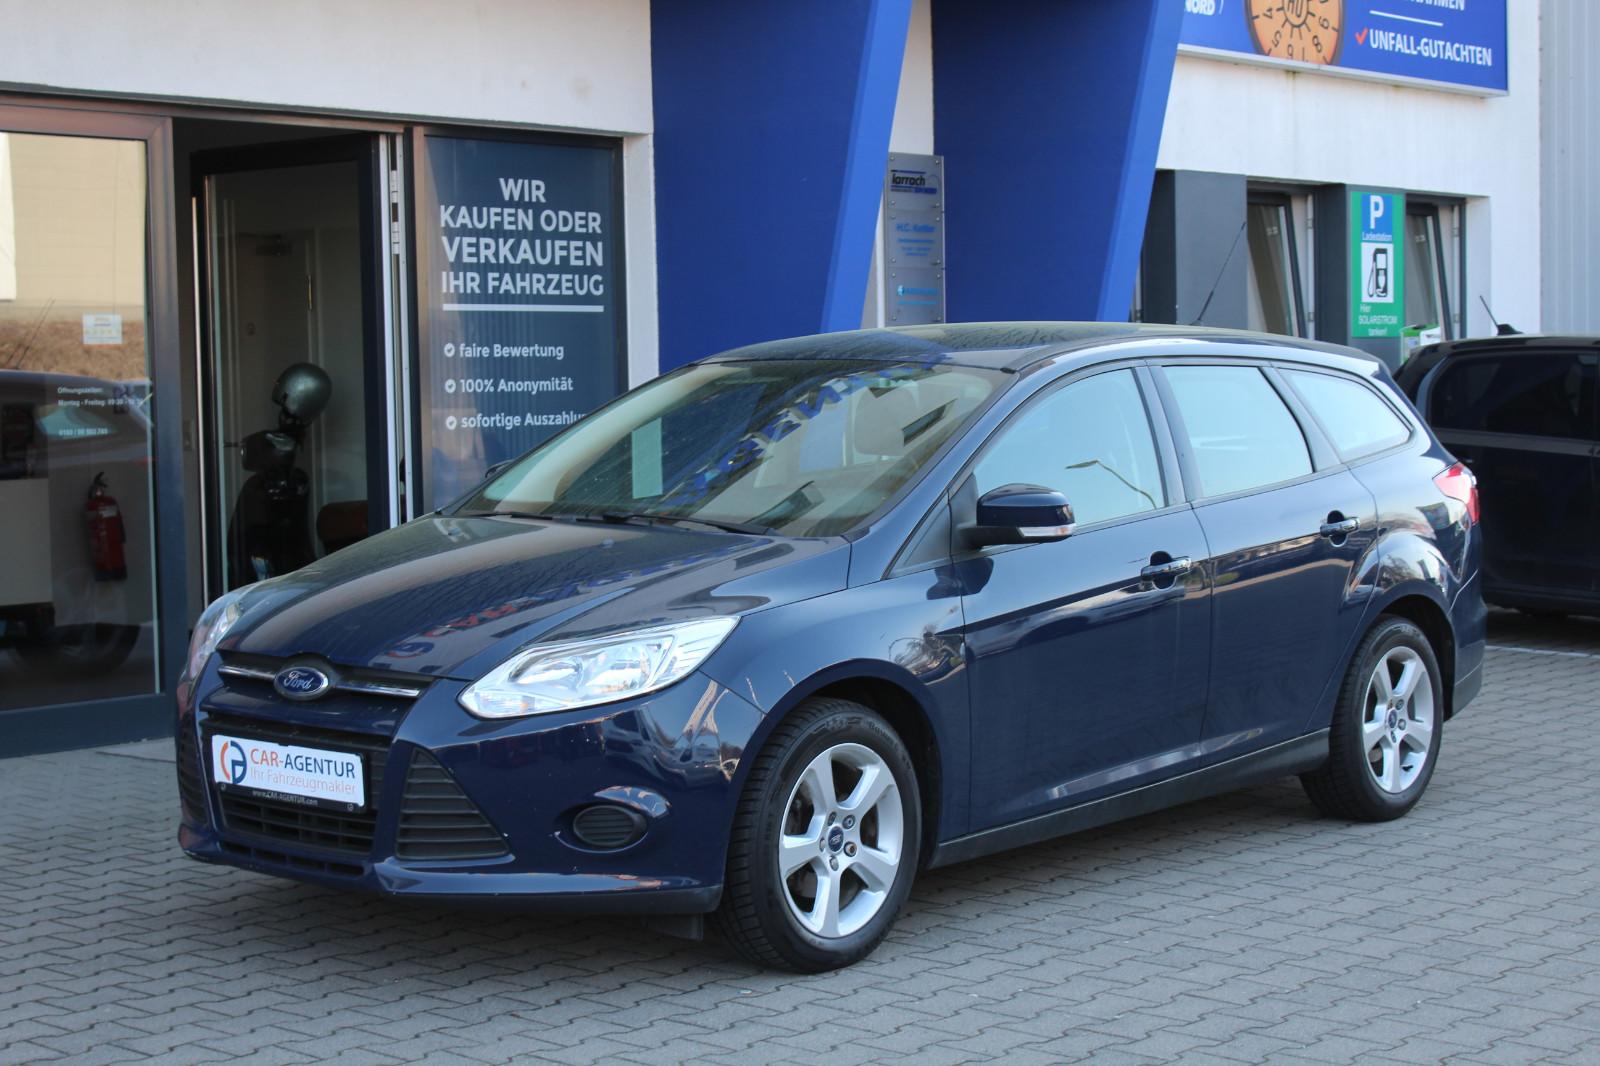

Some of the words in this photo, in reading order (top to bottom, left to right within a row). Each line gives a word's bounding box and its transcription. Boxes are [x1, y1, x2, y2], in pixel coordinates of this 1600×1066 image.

[1368, 28, 1493, 67] UNFALL-GUTACHTEN
[499, 177, 547, 203] WIR
[440, 205, 533, 231] KAUFEN
[540, 209, 602, 234] ODER
[1369, 195, 1384, 229] P
[441, 235, 604, 267] VERKAUFEN
[442, 271, 481, 294] IHR
[487, 272, 605, 296] FAHRZEUG
[459, 343, 490, 358] faire
[493, 343, 564, 360] Bewertung
[460, 378, 495, 393] 100%
[497, 376, 574, 395] Anonymität
[461, 412, 522, 430] sofortige
[283, 670, 312, 690] Ford
[250, 748, 356, 779] CAR-AGENTUR
[250, 767, 264, 778] Ihr
[268, 769, 356, 795] Fahrzeugmakler
